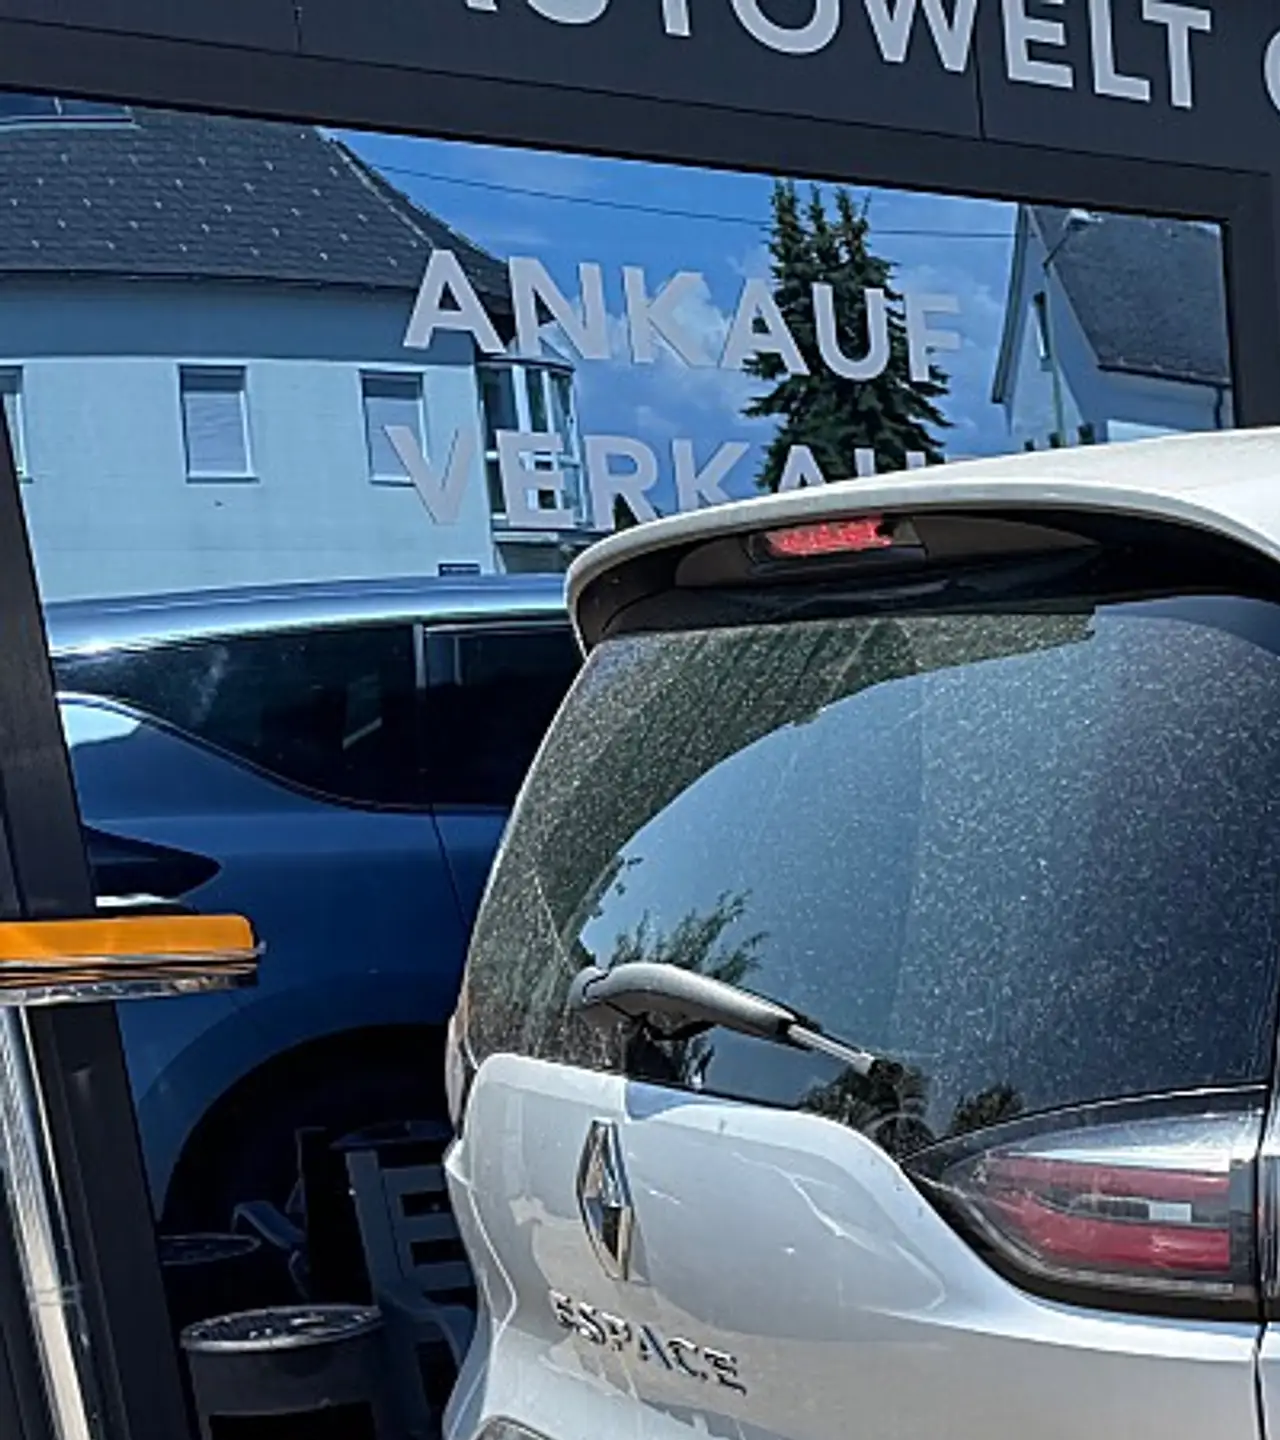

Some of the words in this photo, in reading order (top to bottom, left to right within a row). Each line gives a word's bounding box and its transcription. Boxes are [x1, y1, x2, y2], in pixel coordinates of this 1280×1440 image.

[465, 0, 1211, 108] OWELT
[402, 249, 963, 383] ANKAUF
[383, 423, 985, 530] VERK
[549, 1289, 747, 1397] ESPACE
